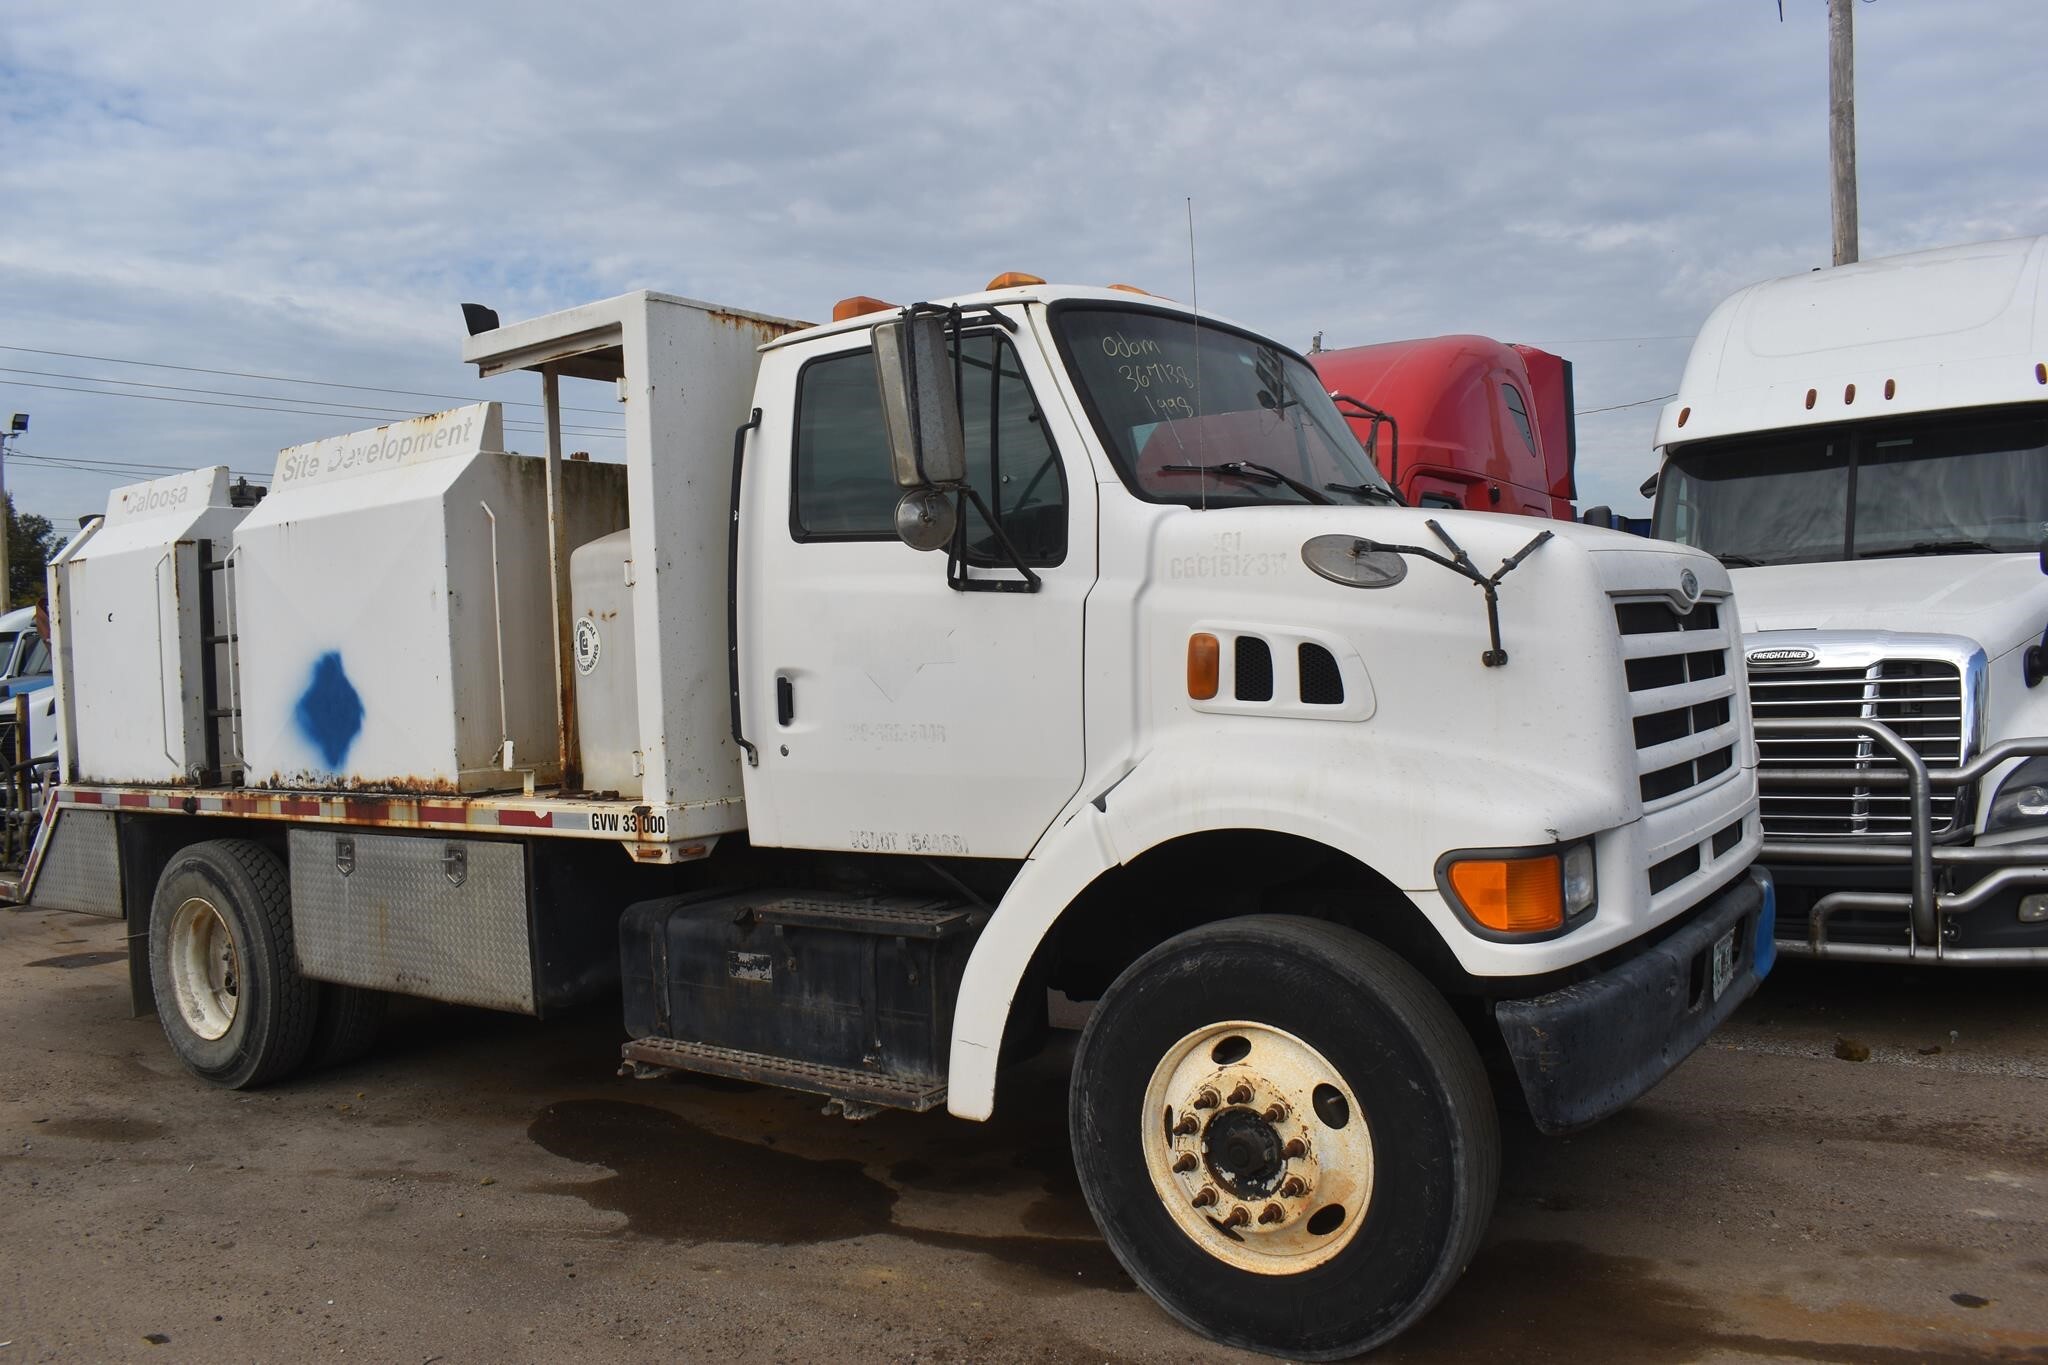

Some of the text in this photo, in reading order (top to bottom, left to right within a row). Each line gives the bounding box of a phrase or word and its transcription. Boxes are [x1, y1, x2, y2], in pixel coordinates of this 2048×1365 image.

[1102, 330, 1161, 358] Odom
[1118, 363, 1194, 392] 367138
[1144, 395, 1194, 418] 1998
[281, 416, 473, 482] Site Development
[126, 486, 188, 515] Caloosa
[1752, 651, 1808, 660] FREIGHTLINER
[591, 812, 666, 834] GVW 33000
